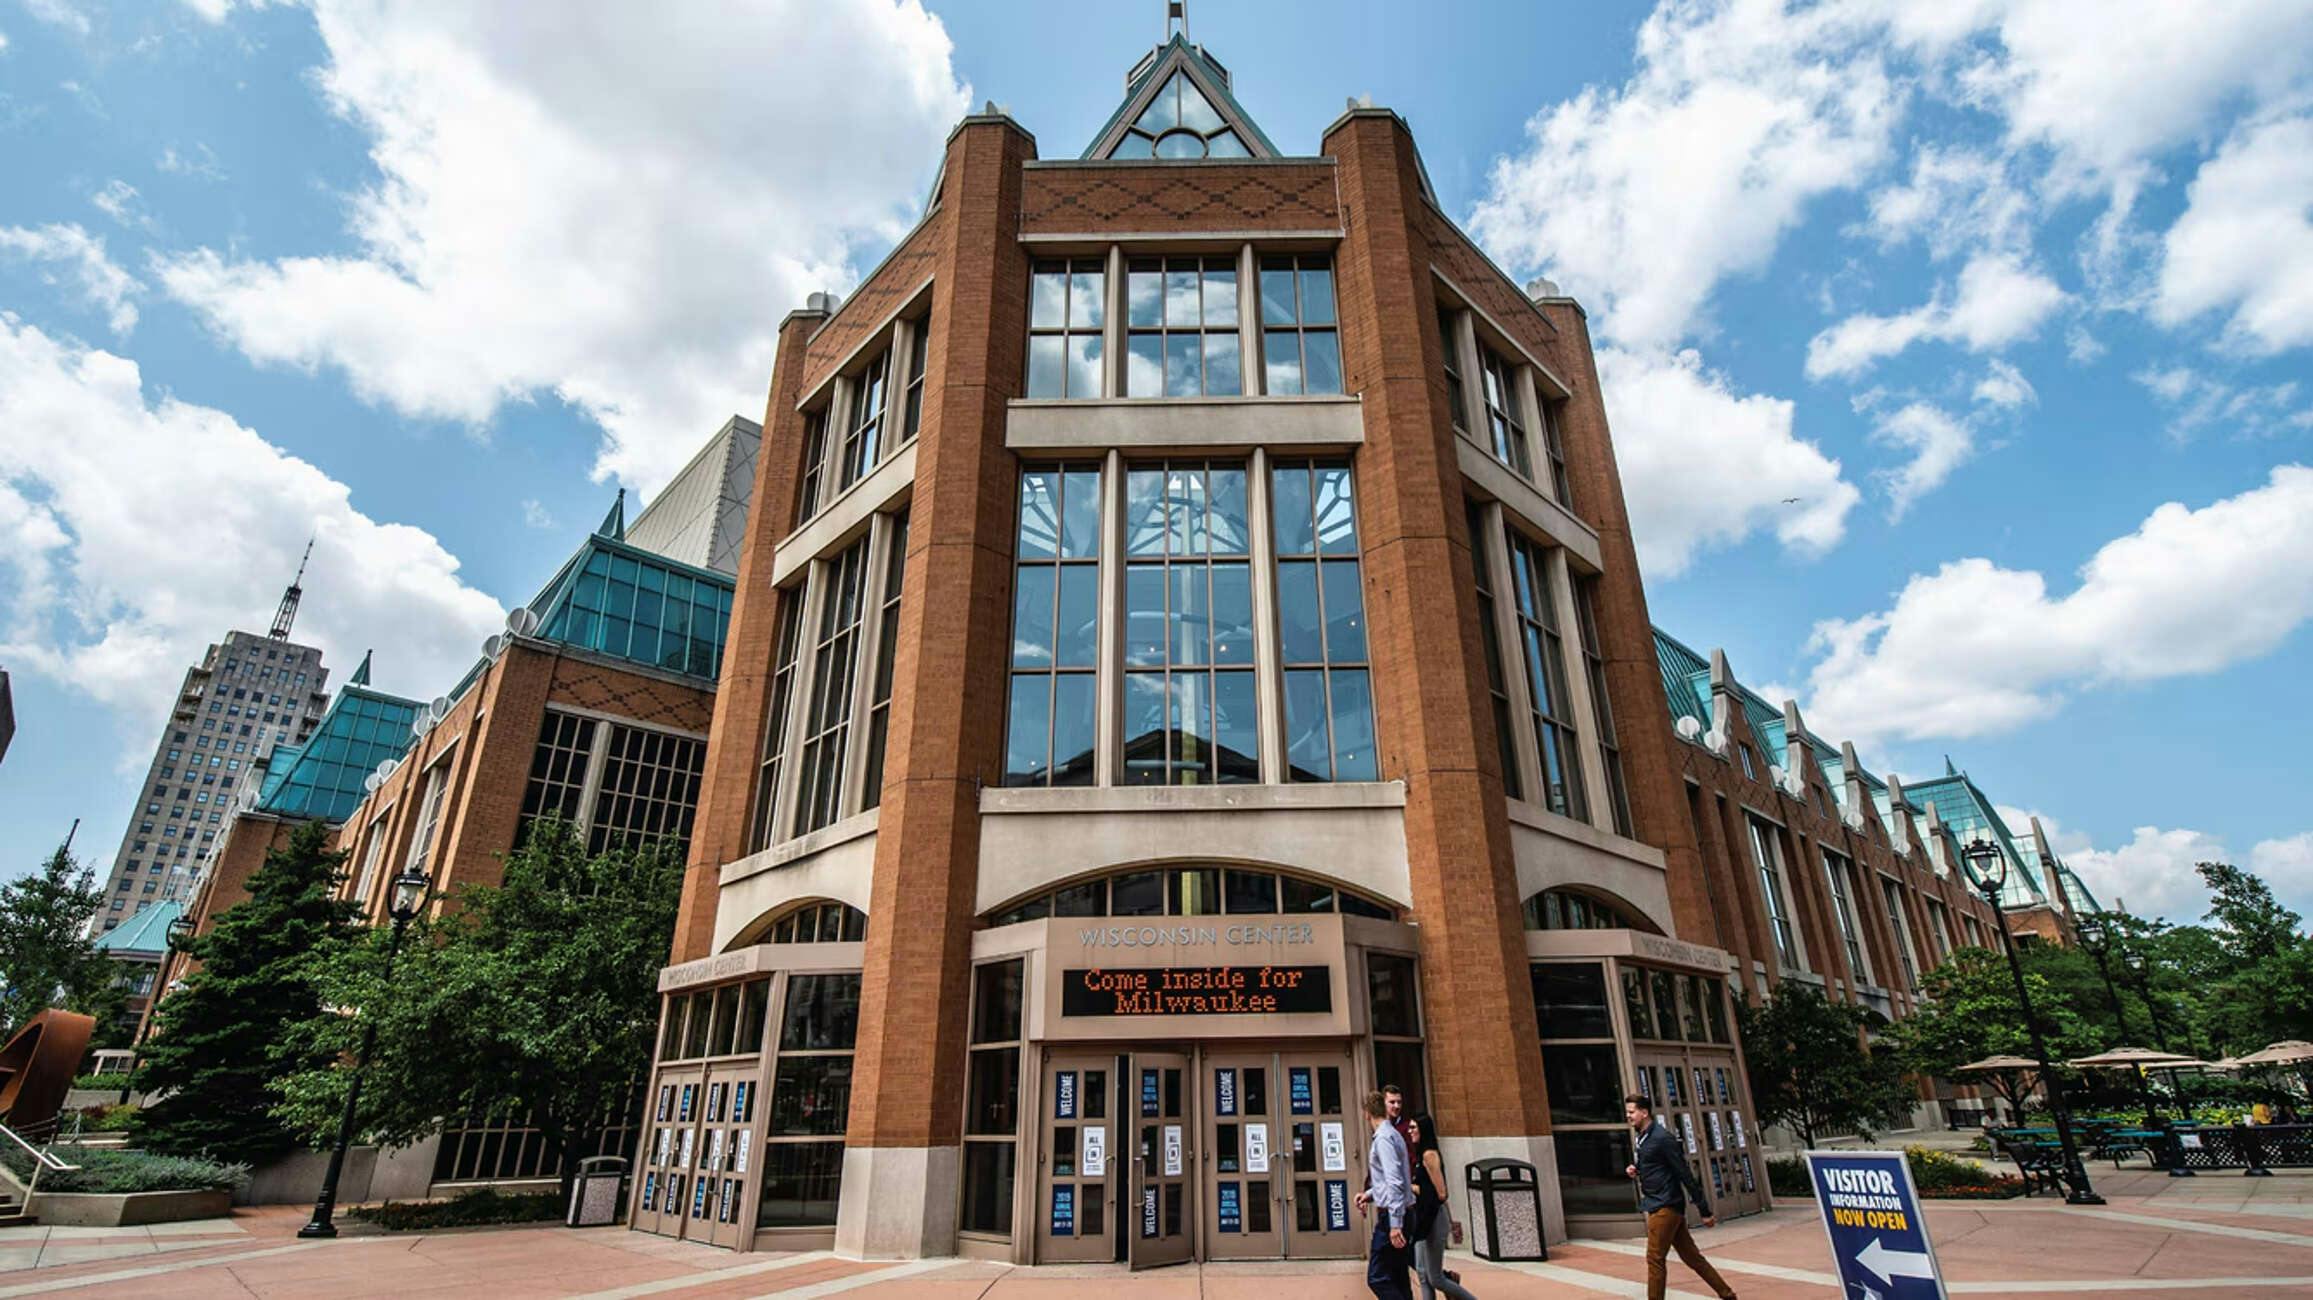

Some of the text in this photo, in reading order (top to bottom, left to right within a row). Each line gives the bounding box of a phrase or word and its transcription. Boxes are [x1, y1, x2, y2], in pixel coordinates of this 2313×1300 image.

[1079, 924, 1314, 947] WISCONSIN CENTER
[1085, 965, 1303, 991] Come inside for
[1115, 990, 1277, 1013] Milwaukee
[1060, 1075, 1073, 1115] WELCOME
[1822, 1168, 1897, 1195] VISITOR
[1145, 1189, 1155, 1235] WELCOME
[1330, 1184, 1344, 1227] WELCOME
[1830, 1194, 1902, 1211] INFORMATION
[1833, 1208, 1908, 1230] NOW OPEN
